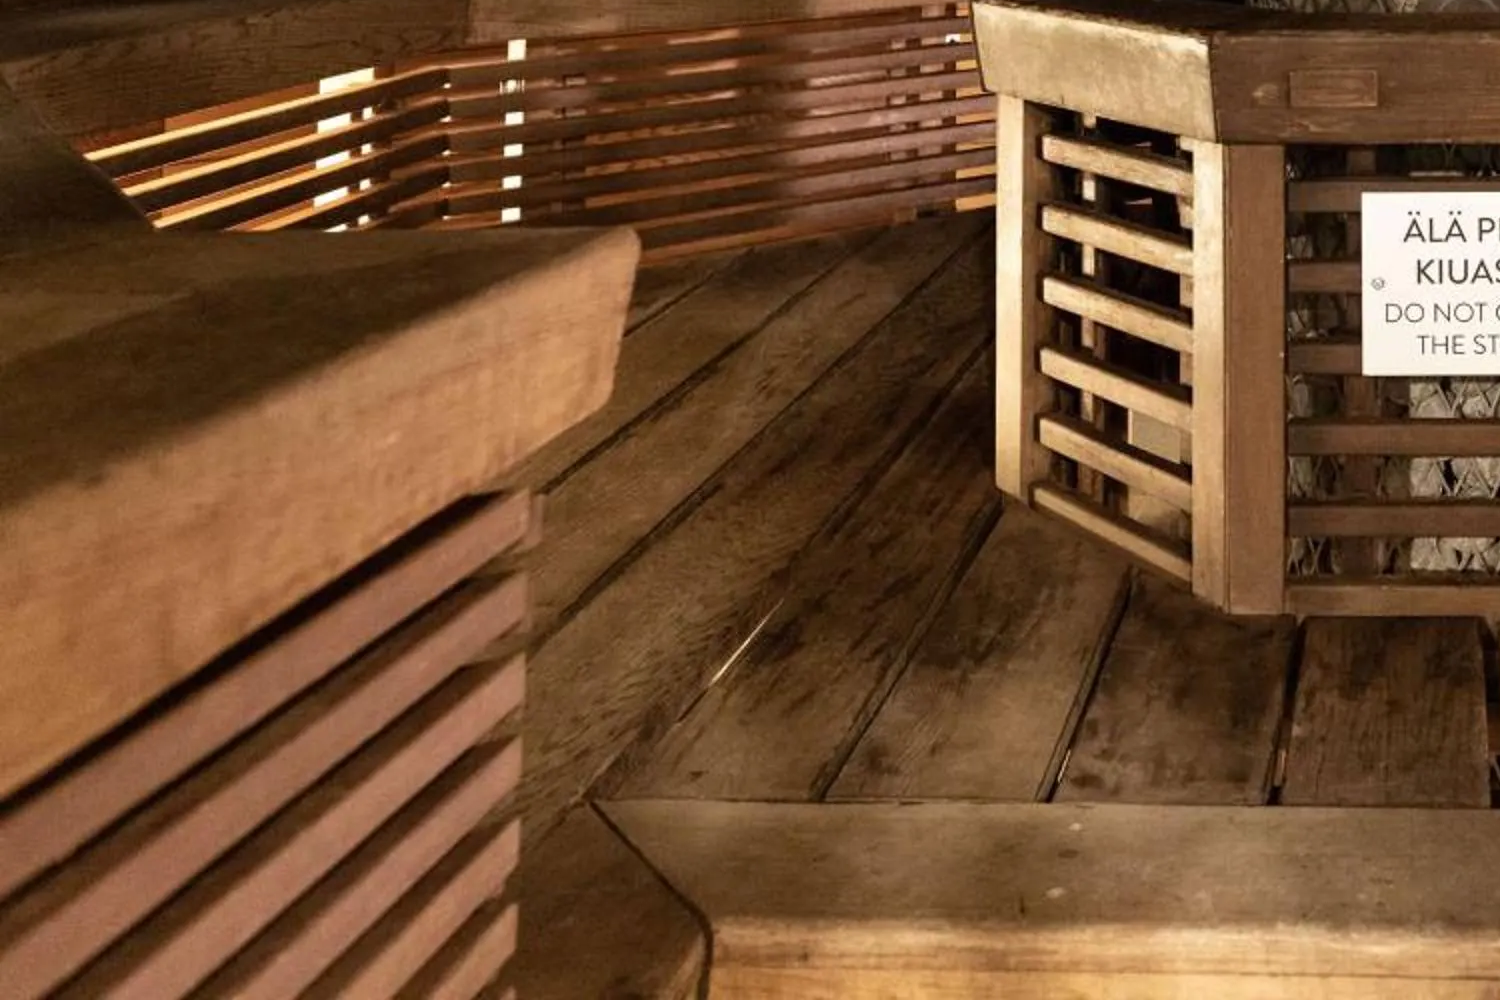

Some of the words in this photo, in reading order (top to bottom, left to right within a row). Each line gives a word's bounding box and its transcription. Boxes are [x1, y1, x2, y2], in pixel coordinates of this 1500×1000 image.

[1403, 210, 1468, 243] ÄLÄ
[1385, 302, 1426, 323] DO
[1433, 302, 1488, 323] NOT
[1417, 334, 1466, 355] THE
